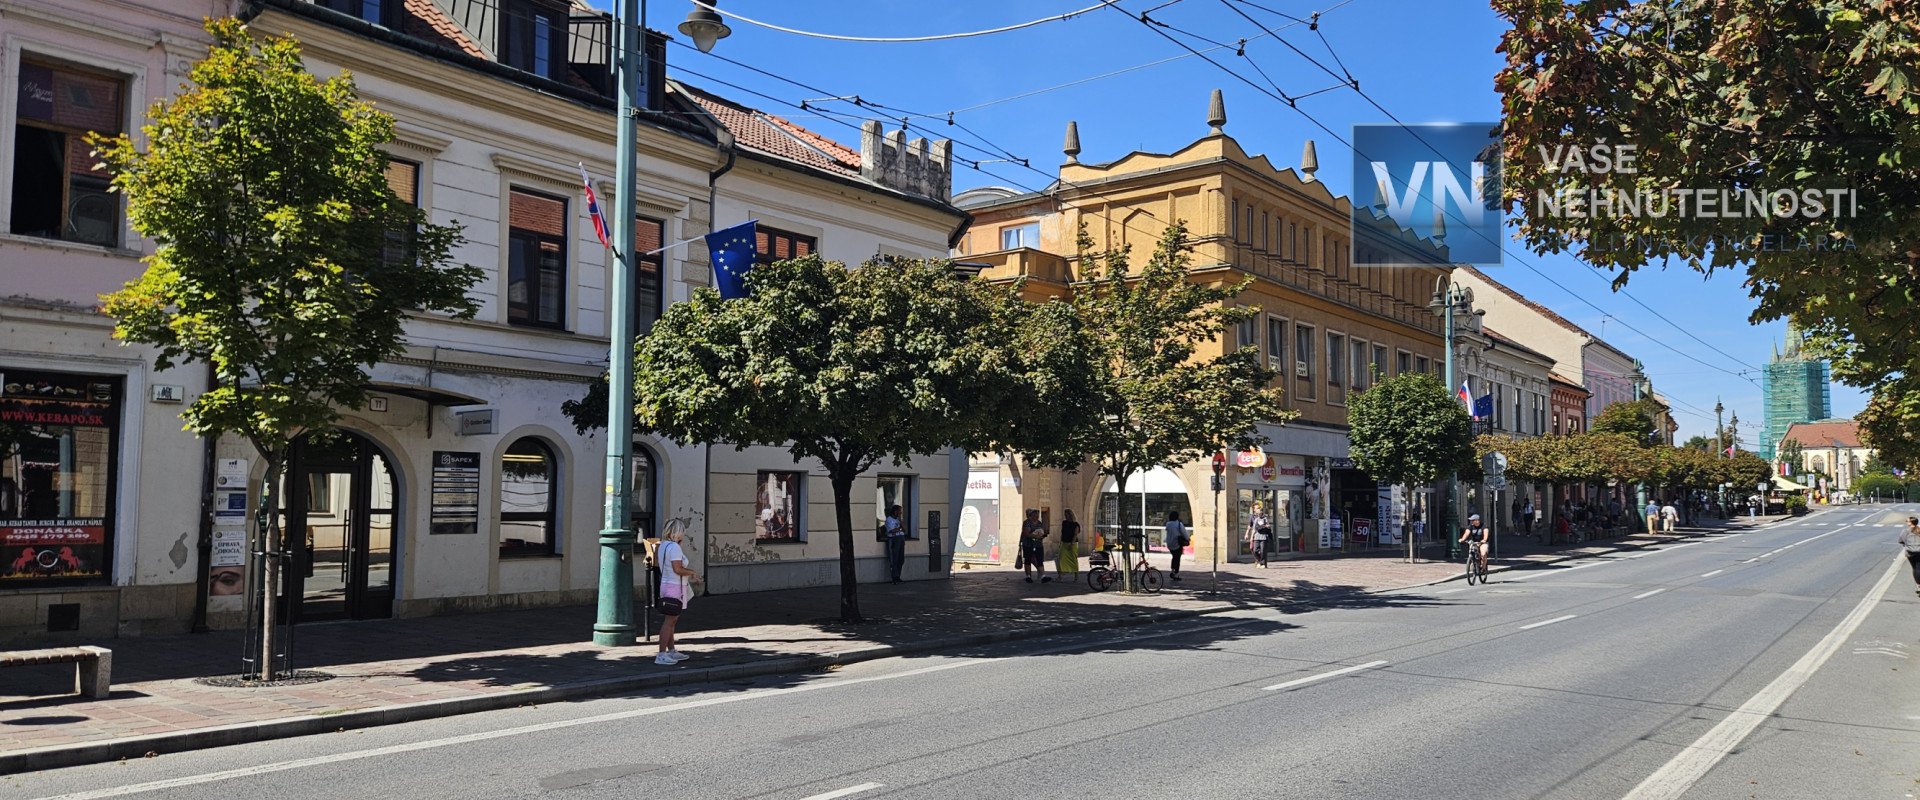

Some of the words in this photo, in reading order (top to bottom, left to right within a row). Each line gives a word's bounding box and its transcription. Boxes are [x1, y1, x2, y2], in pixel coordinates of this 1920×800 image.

[1, 411, 104, 425] WWW.KEBAPO.SK
[1241, 454, 1260, 463] teta
[1263, 466, 1275, 476] teta
